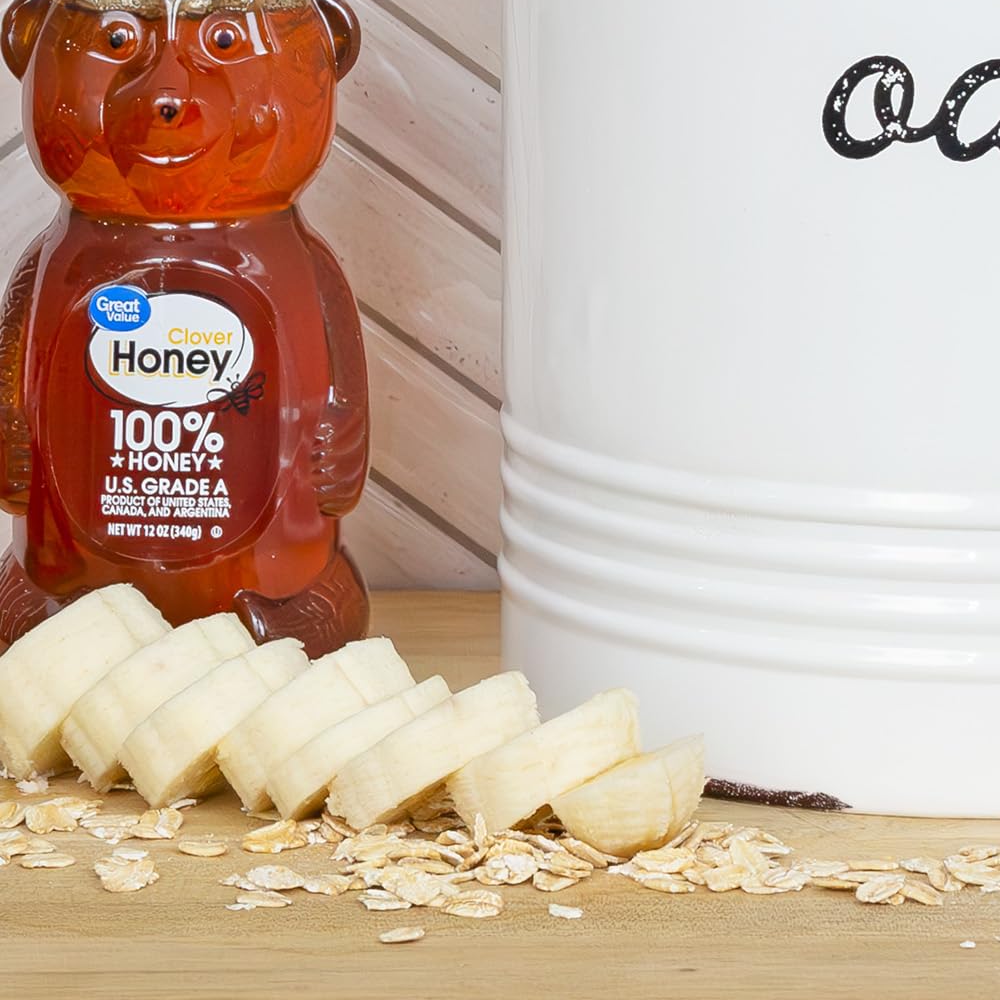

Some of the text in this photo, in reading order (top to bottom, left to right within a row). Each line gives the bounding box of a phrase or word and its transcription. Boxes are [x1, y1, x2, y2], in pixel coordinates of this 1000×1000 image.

[96, 295, 141, 313] Great
[106, 311, 140, 323] Value
[168, 327, 233, 345] Clover
[110, 340, 232, 383] Honey
[110, 409, 224, 453] 100%
[128, 452, 206, 472] HONEY
[105, 476, 229, 496] U.S. GRADE A
[100, 495, 232, 509] PRODUCT OF UNITED STATES,
[102, 505, 230, 518] CANADA, AND ARGENTINA
[108, 522, 202, 541] NET WT 12 OZ (340g)
